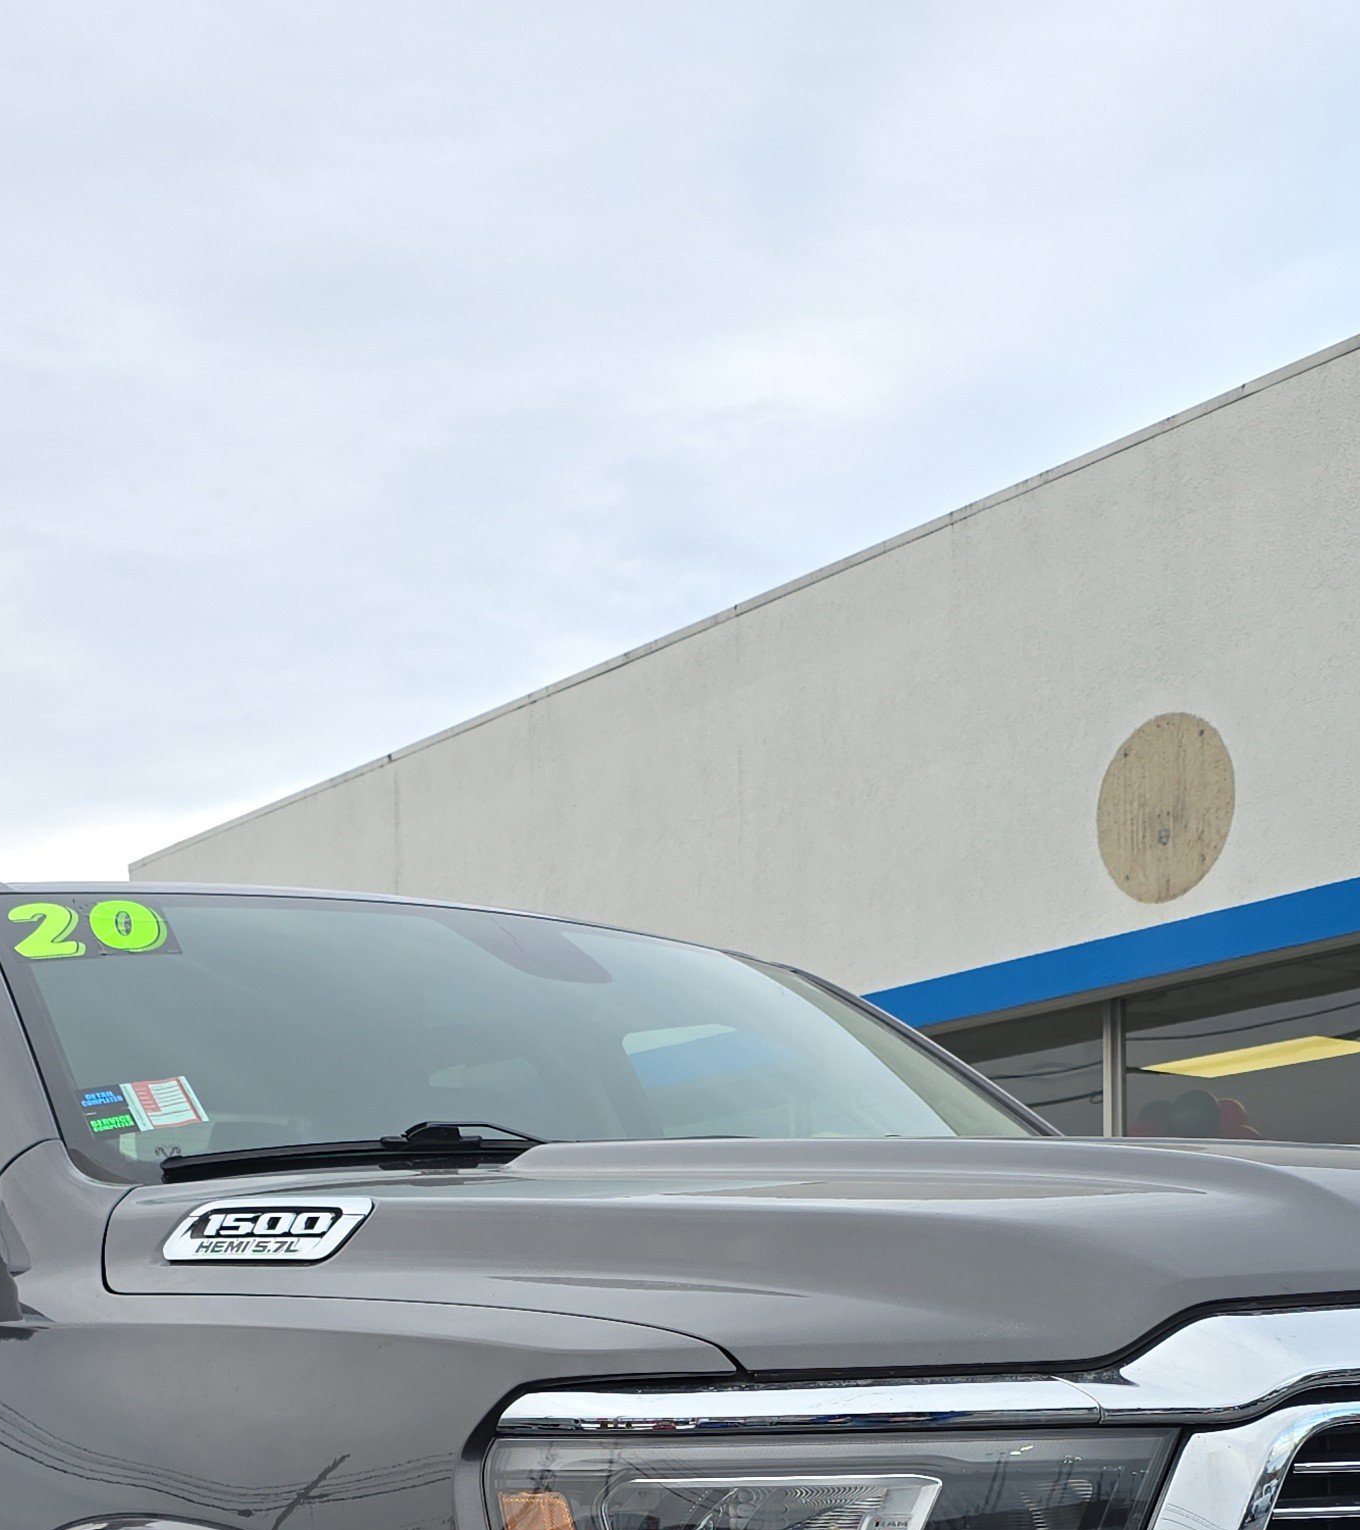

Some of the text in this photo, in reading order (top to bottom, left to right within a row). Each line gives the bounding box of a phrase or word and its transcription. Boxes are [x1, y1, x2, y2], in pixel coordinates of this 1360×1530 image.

[7, 899, 167, 959] 20
[203, 1211, 336, 1236] 1500
[194, 1238, 302, 1254] HEMI 5.7L
